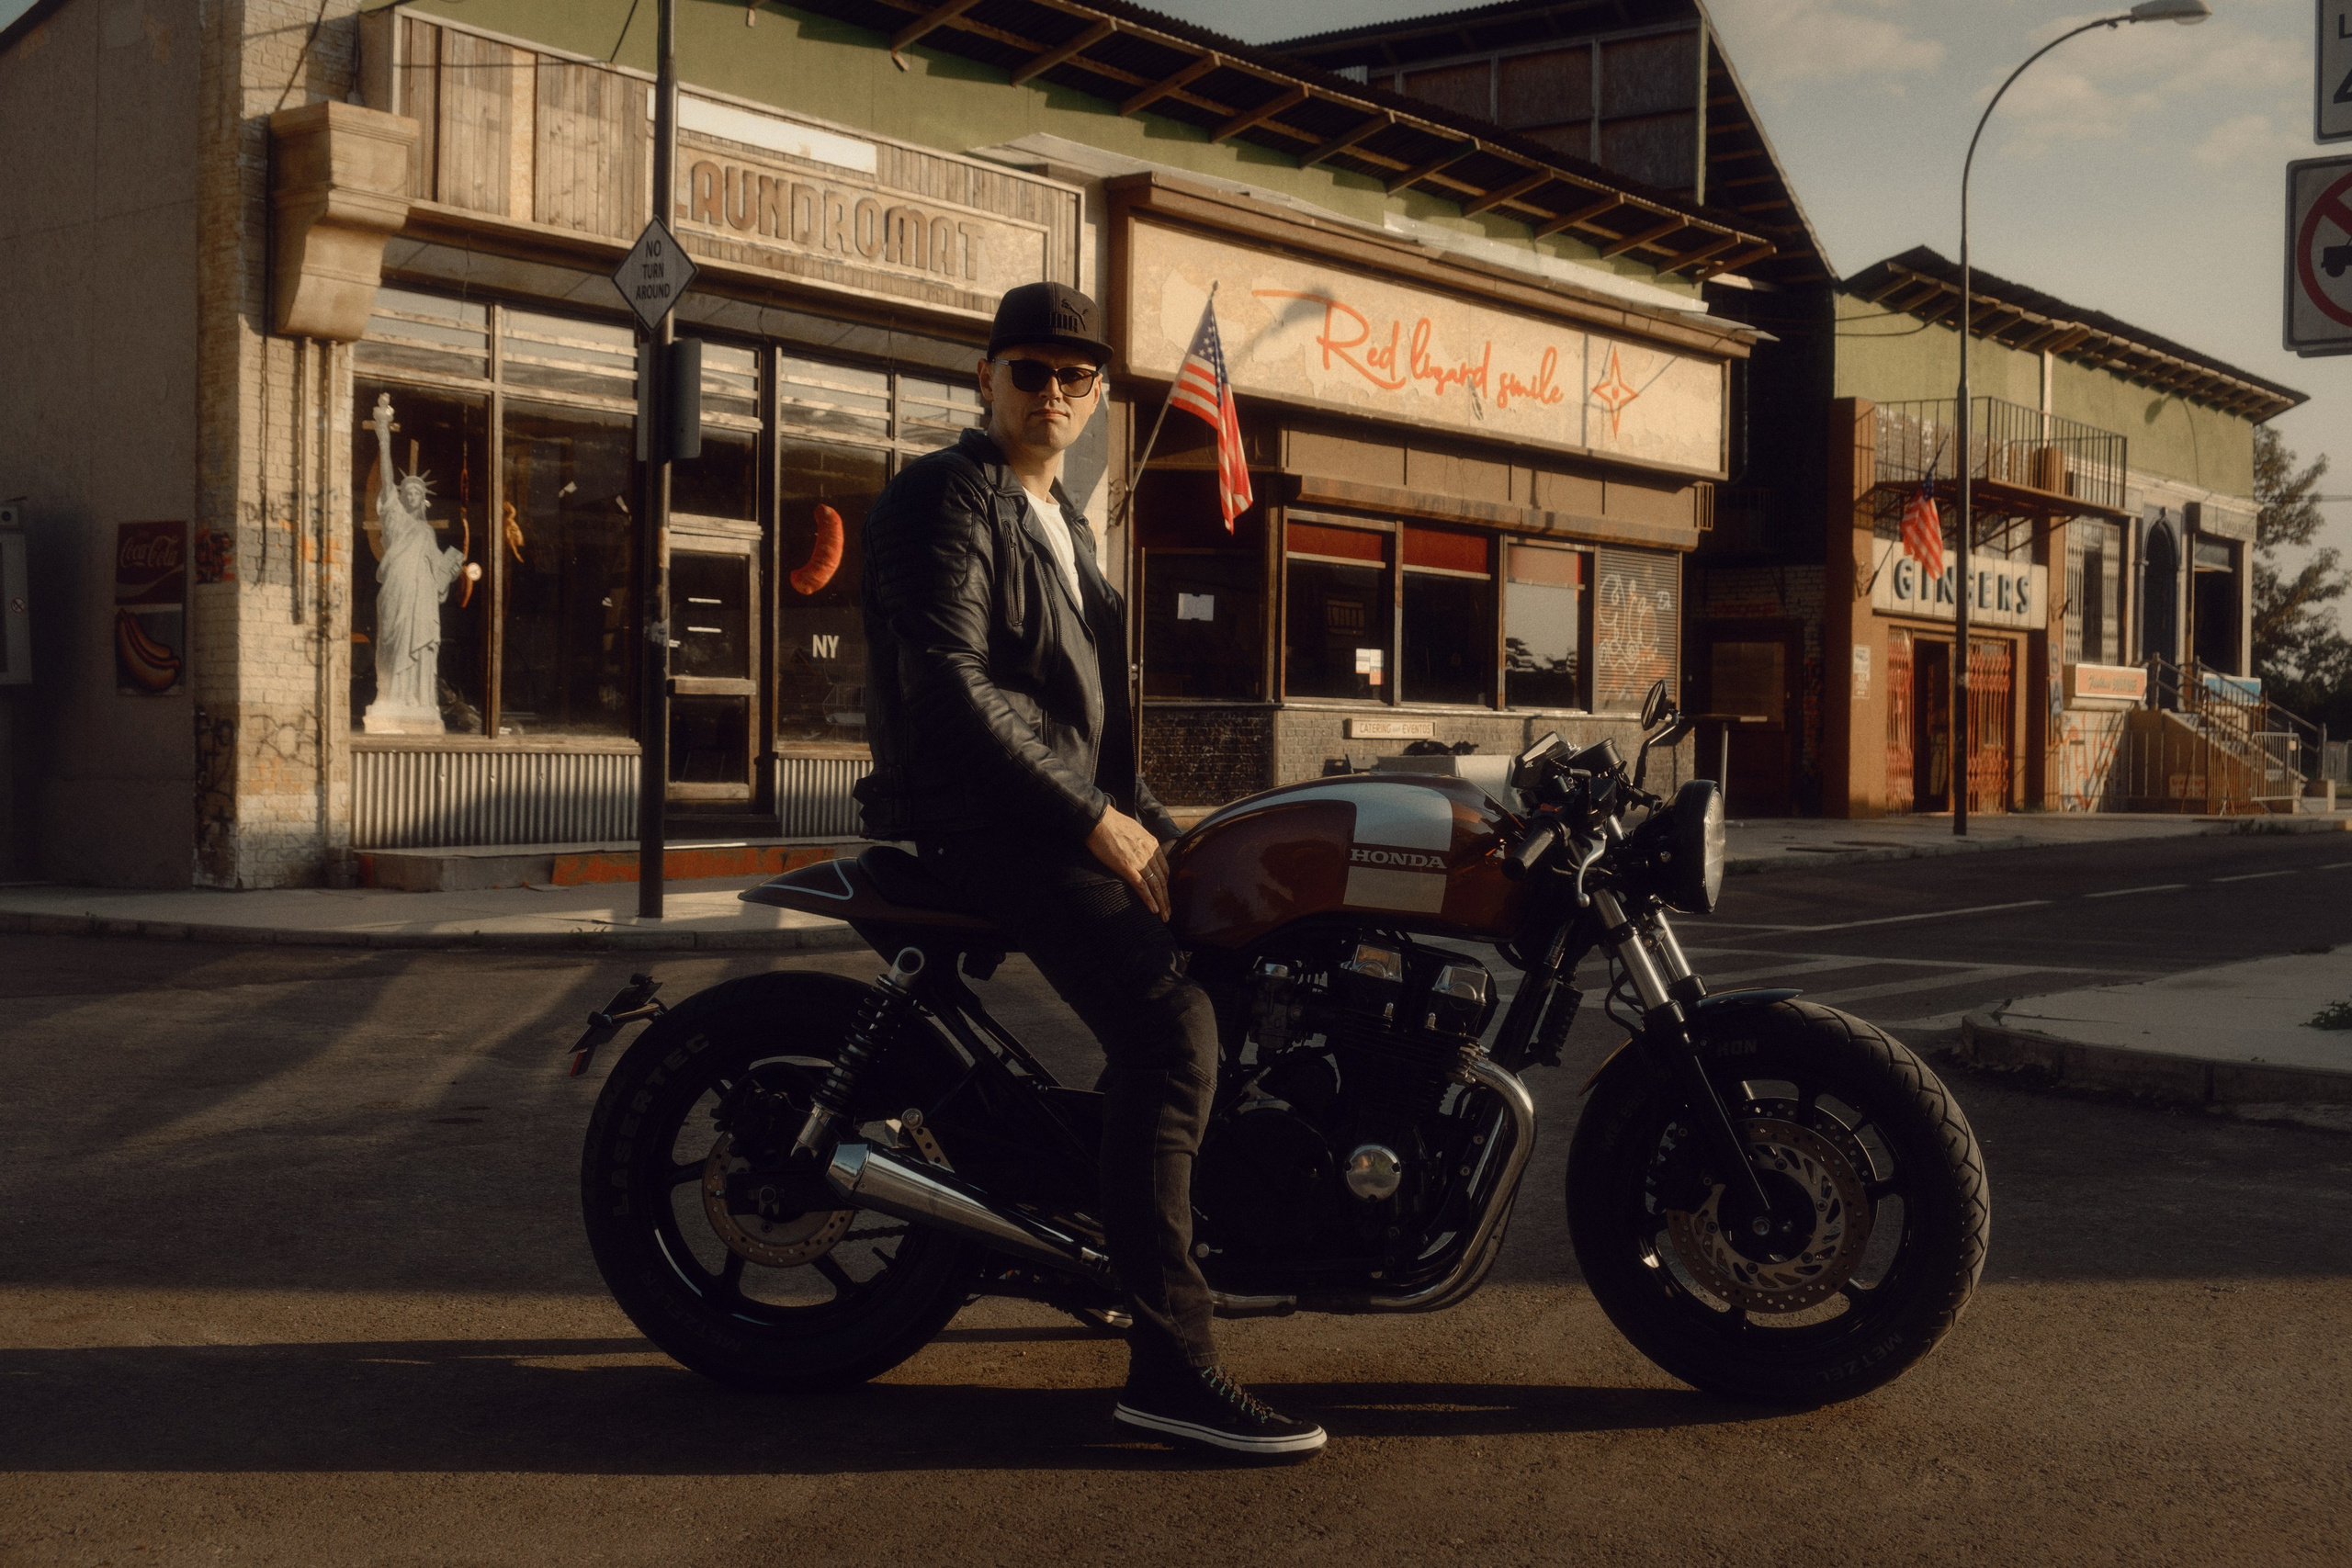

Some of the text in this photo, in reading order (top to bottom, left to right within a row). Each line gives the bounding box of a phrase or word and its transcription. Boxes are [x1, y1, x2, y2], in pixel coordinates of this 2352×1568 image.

[676, 159, 985, 281] AUNDROMAT
[645, 240, 662, 258] NO
[642, 262, 665, 279] TURN
[635, 282, 671, 301] AROUND
[1252, 288, 1564, 409] Red lizard smile
[811, 634, 841, 660] NY
[1360, 723, 1391, 734] CATERING
[1402, 723, 1431, 735] EVENTOS
[1350, 848, 1448, 869] HONDA
[610, 1032, 710, 1216] LASERTEC
